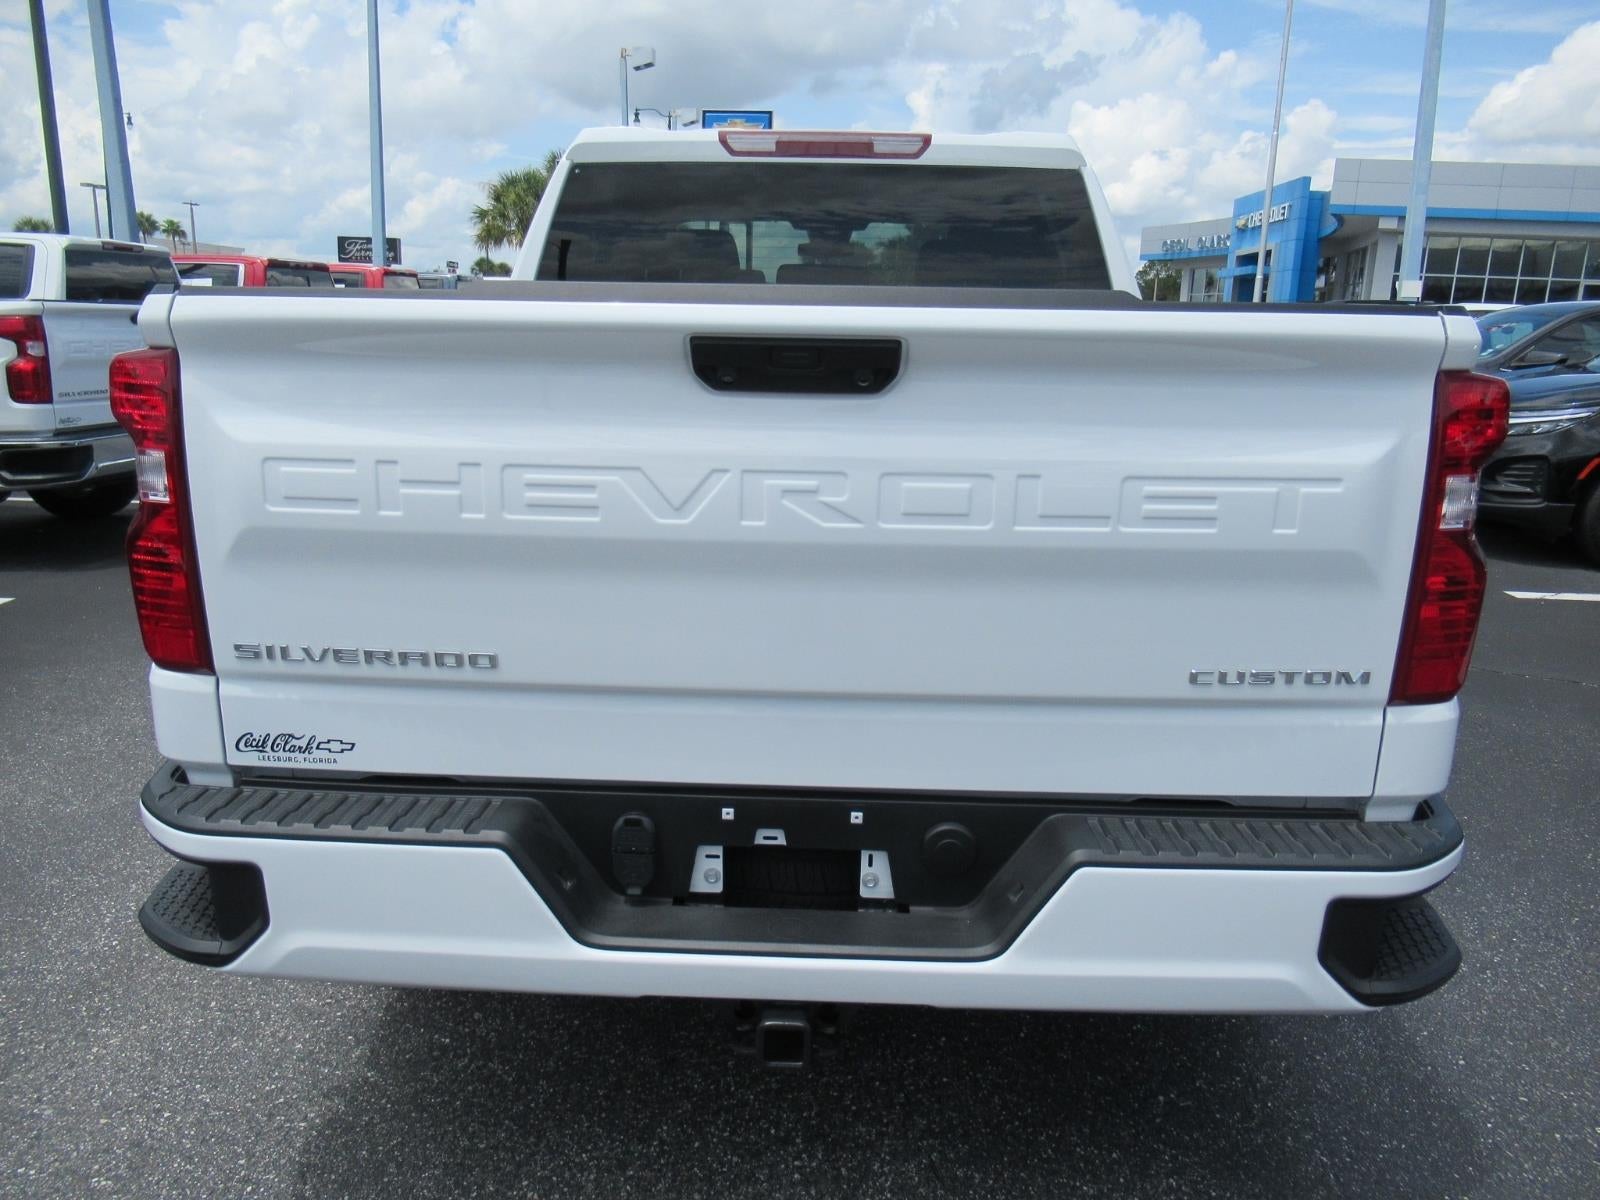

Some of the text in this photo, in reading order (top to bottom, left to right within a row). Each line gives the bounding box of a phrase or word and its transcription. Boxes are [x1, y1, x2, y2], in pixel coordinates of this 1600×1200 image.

[1248, 202, 1290, 228] CHEOLET
[262, 457, 1344, 536] CHEVROLET
[233, 642, 498, 669] SILVERADO
[1189, 669, 1371, 686] CUSTOM
[235, 732, 317, 755] Cecil Clark
[257, 755, 338, 764] LEESBURG, FLORIDA
